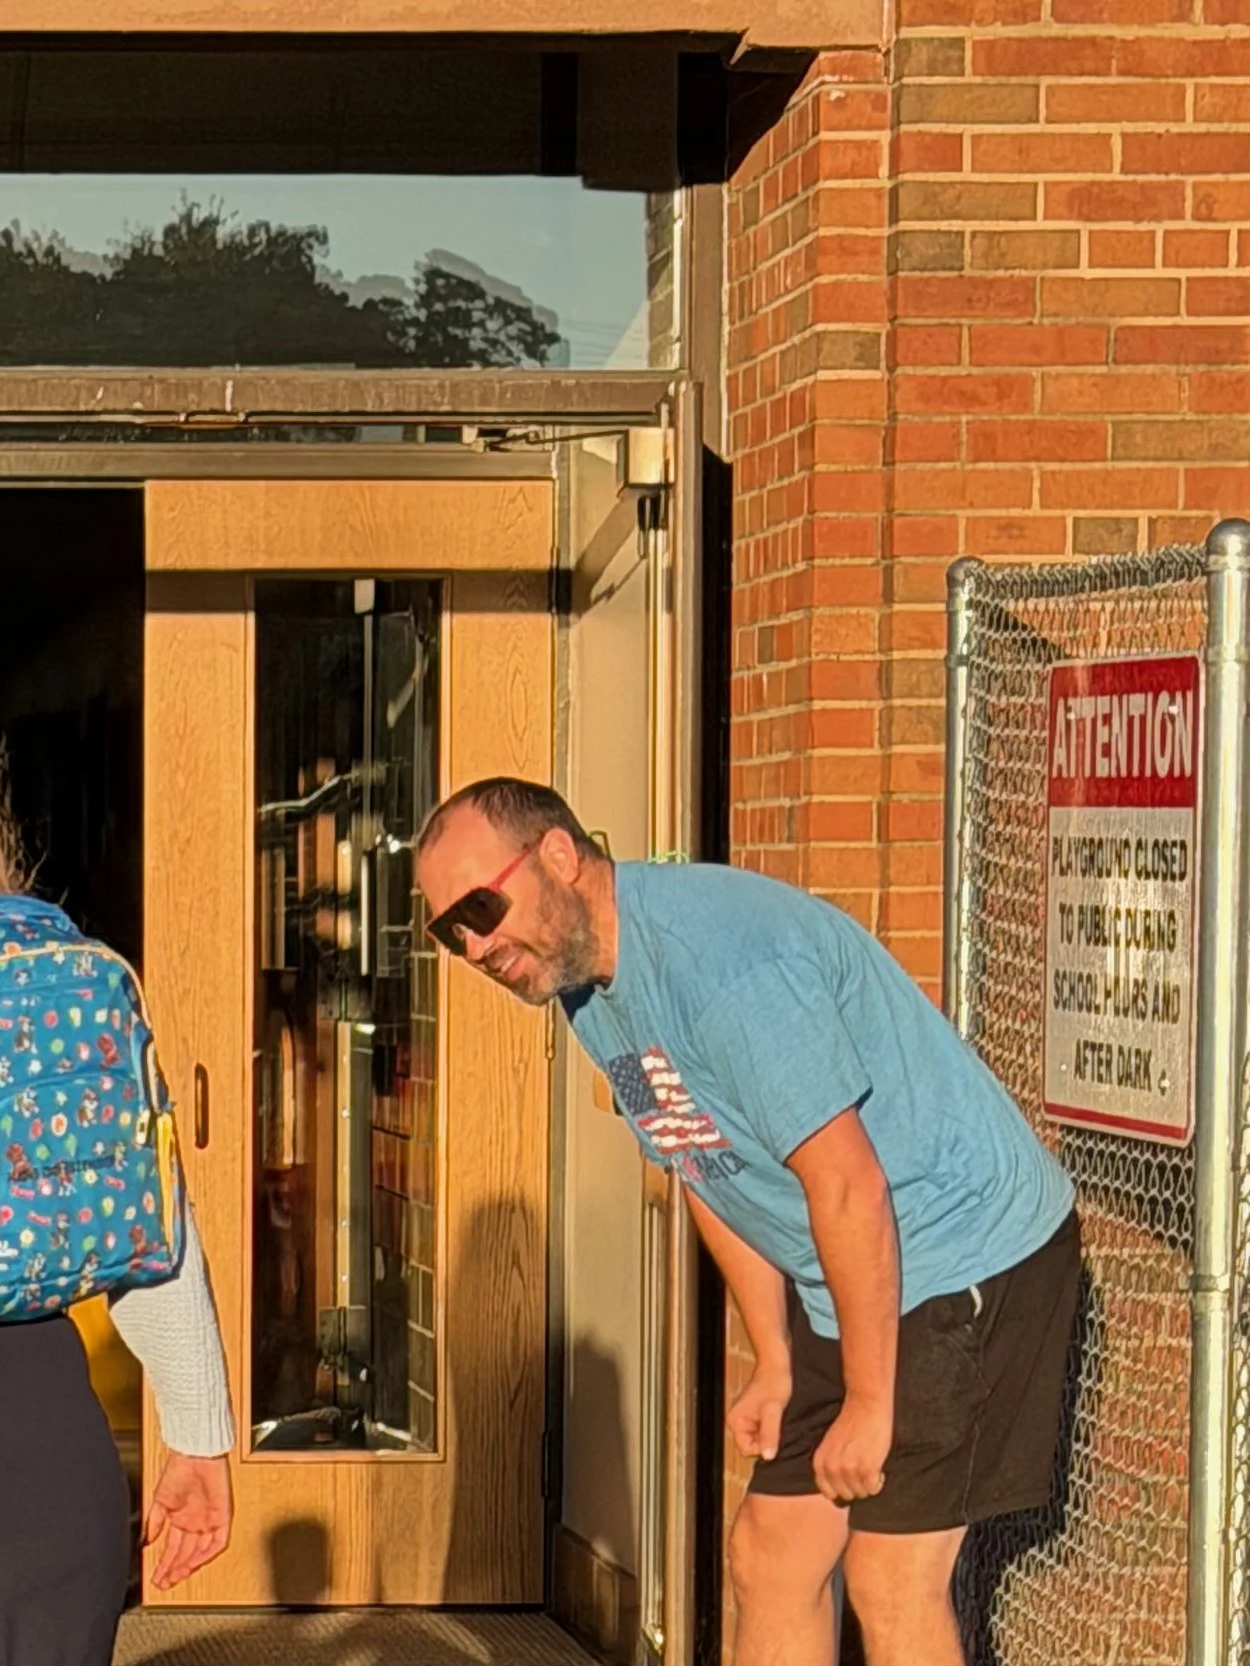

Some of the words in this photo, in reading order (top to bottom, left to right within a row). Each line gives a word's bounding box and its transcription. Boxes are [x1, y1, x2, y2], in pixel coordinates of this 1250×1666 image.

[1052, 685, 1193, 778] ATTENTION
[1051, 836, 1132, 881] PLAYGROUND
[1134, 837, 1188, 883] CLOSED
[1058, 901, 1074, 945] TO
[1077, 904, 1121, 949] PUBLIC
[1125, 906, 1177, 953] DURING
[1053, 968, 1101, 1016] SCHOOL
[1103, 972, 1149, 1022] HOURS
[1151, 979, 1181, 1025] AND
[1074, 1037, 1114, 1086] AFTER
[1116, 1043, 1152, 1093] DARK
